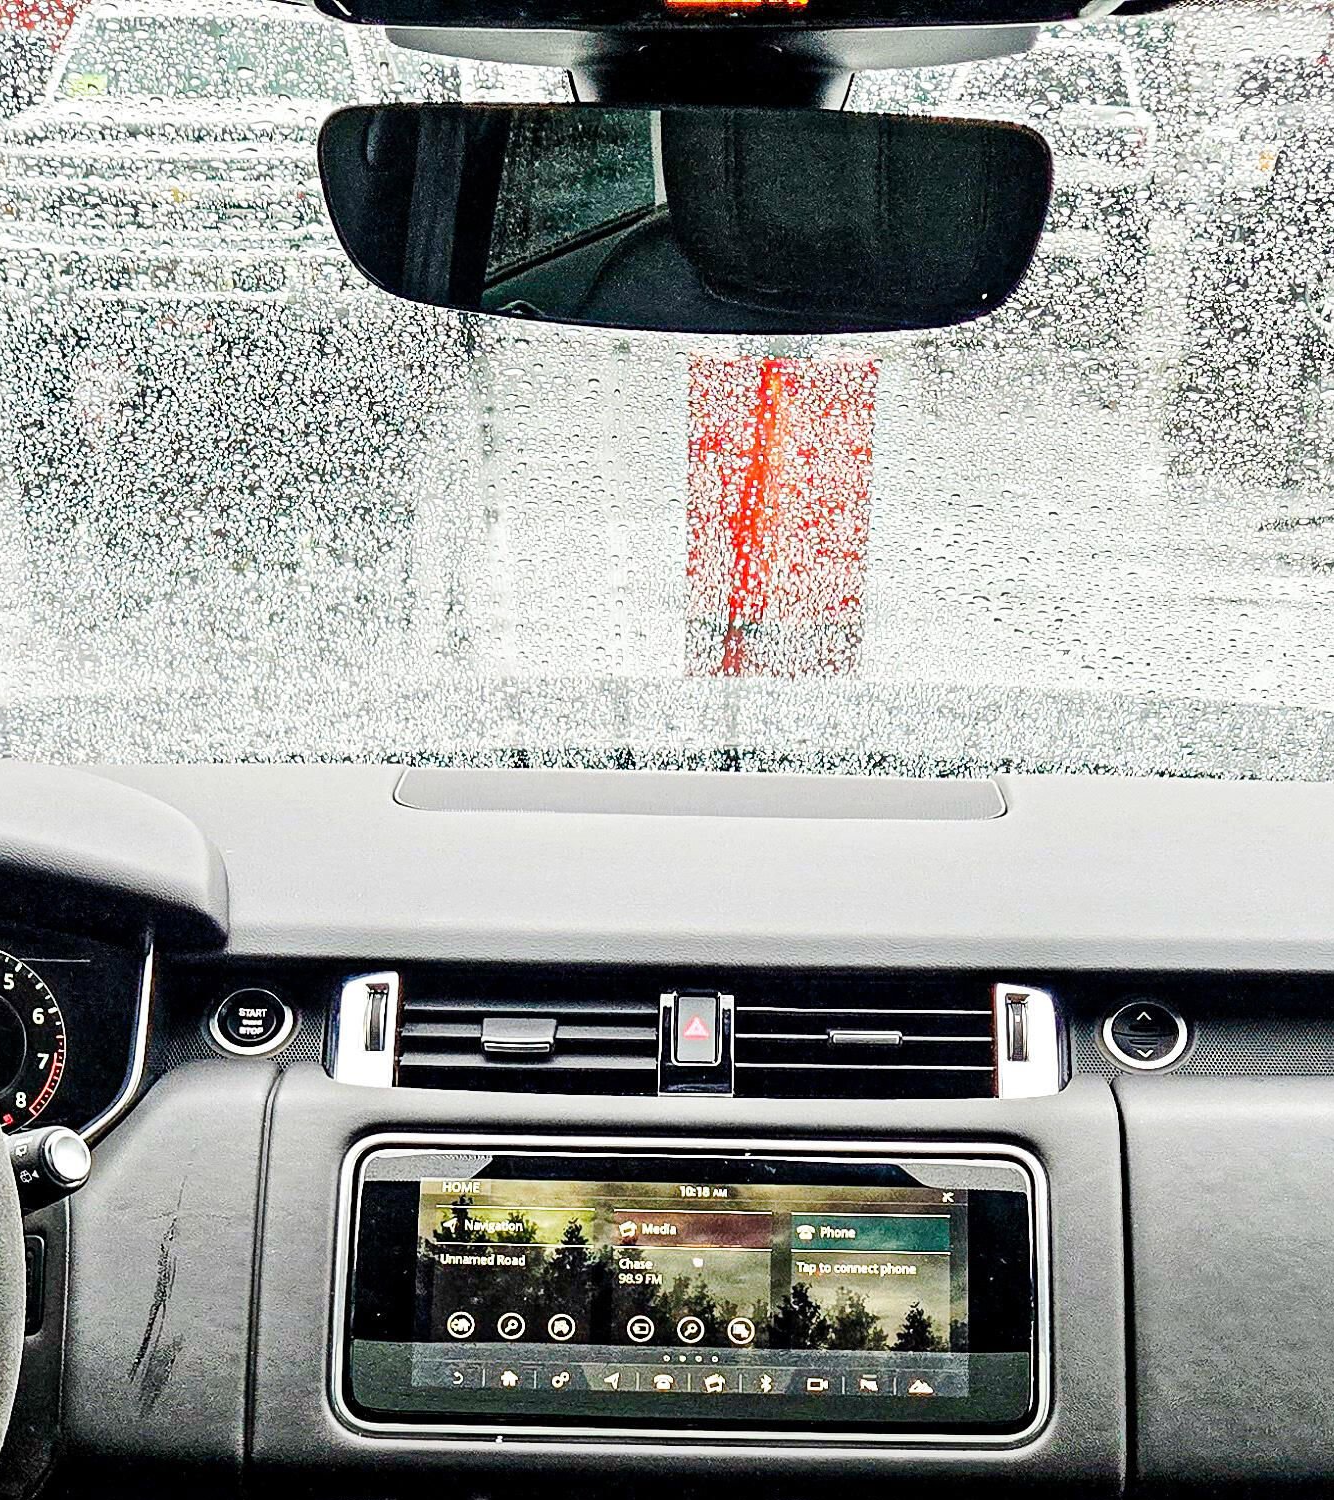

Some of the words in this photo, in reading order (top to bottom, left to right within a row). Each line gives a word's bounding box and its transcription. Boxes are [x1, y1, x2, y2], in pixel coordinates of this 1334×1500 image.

[3, 973, 15, 990] 5
[32, 1008, 44, 1025] 6
[238, 1007, 268, 1018] START
[239, 1026, 264, 1035] STOP
[37, 1052, 50, 1070] 7
[15, 1091, 27, 1109] 8
[441, 1181, 481, 1194] HOME
[712, 1188, 728, 1198] AM
[464, 1219, 524, 1234] Navigation
[641, 1222, 677, 1236] Media
[819, 1225, 856, 1239] Phone
[439, 1253, 495, 1266] Unnamed
[496, 1254, 526, 1267] Road
[618, 1258, 653, 1270] Chase
[796, 1261, 817, 1276] Tap
[819, 1262, 832, 1274] to
[834, 1263, 879, 1274] connect
[880, 1262, 917, 1277] phone
[618, 1273, 644, 1285] 98.9
[645, 1274, 663, 1285] FM
